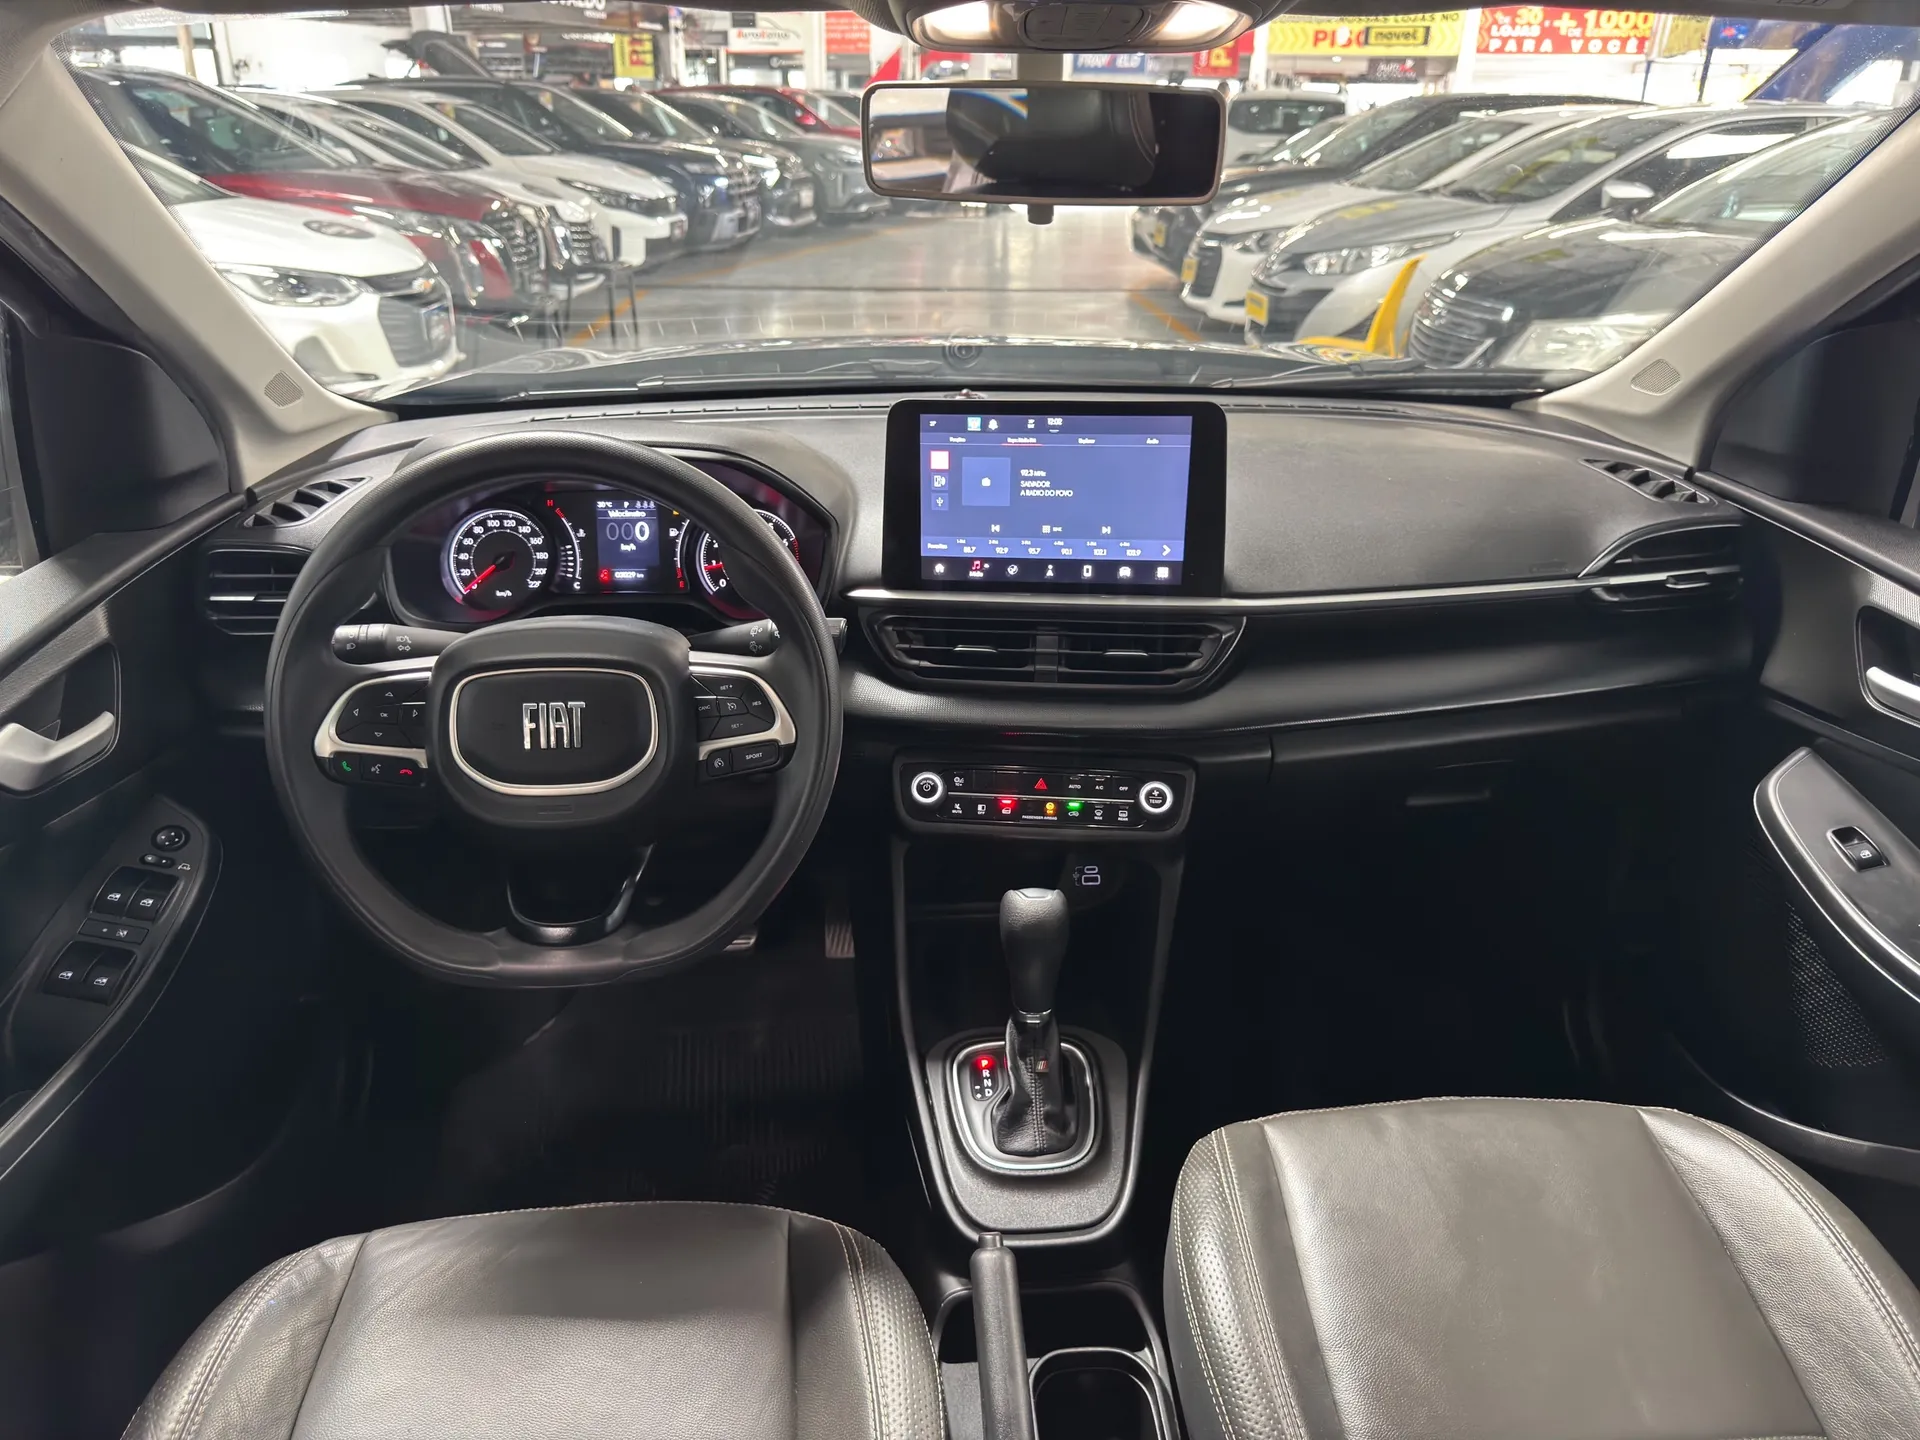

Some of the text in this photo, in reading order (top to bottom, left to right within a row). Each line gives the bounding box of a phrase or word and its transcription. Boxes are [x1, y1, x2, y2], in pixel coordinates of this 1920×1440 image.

[1488, 38, 1554, 53] PARA
[473, 526, 484, 534] 80
[529, 537, 543, 545] 160
[620, 543, 636, 551] km/h
[719, 579, 727, 587] 0
[522, 702, 586, 749] FIAT
[745, 752, 763, 760] SPORT
[981, 1060, 988, 1068] P
[982, 1069, 990, 1077] R
[984, 1079, 992, 1087] N
[985, 1088, 992, 1096] D
